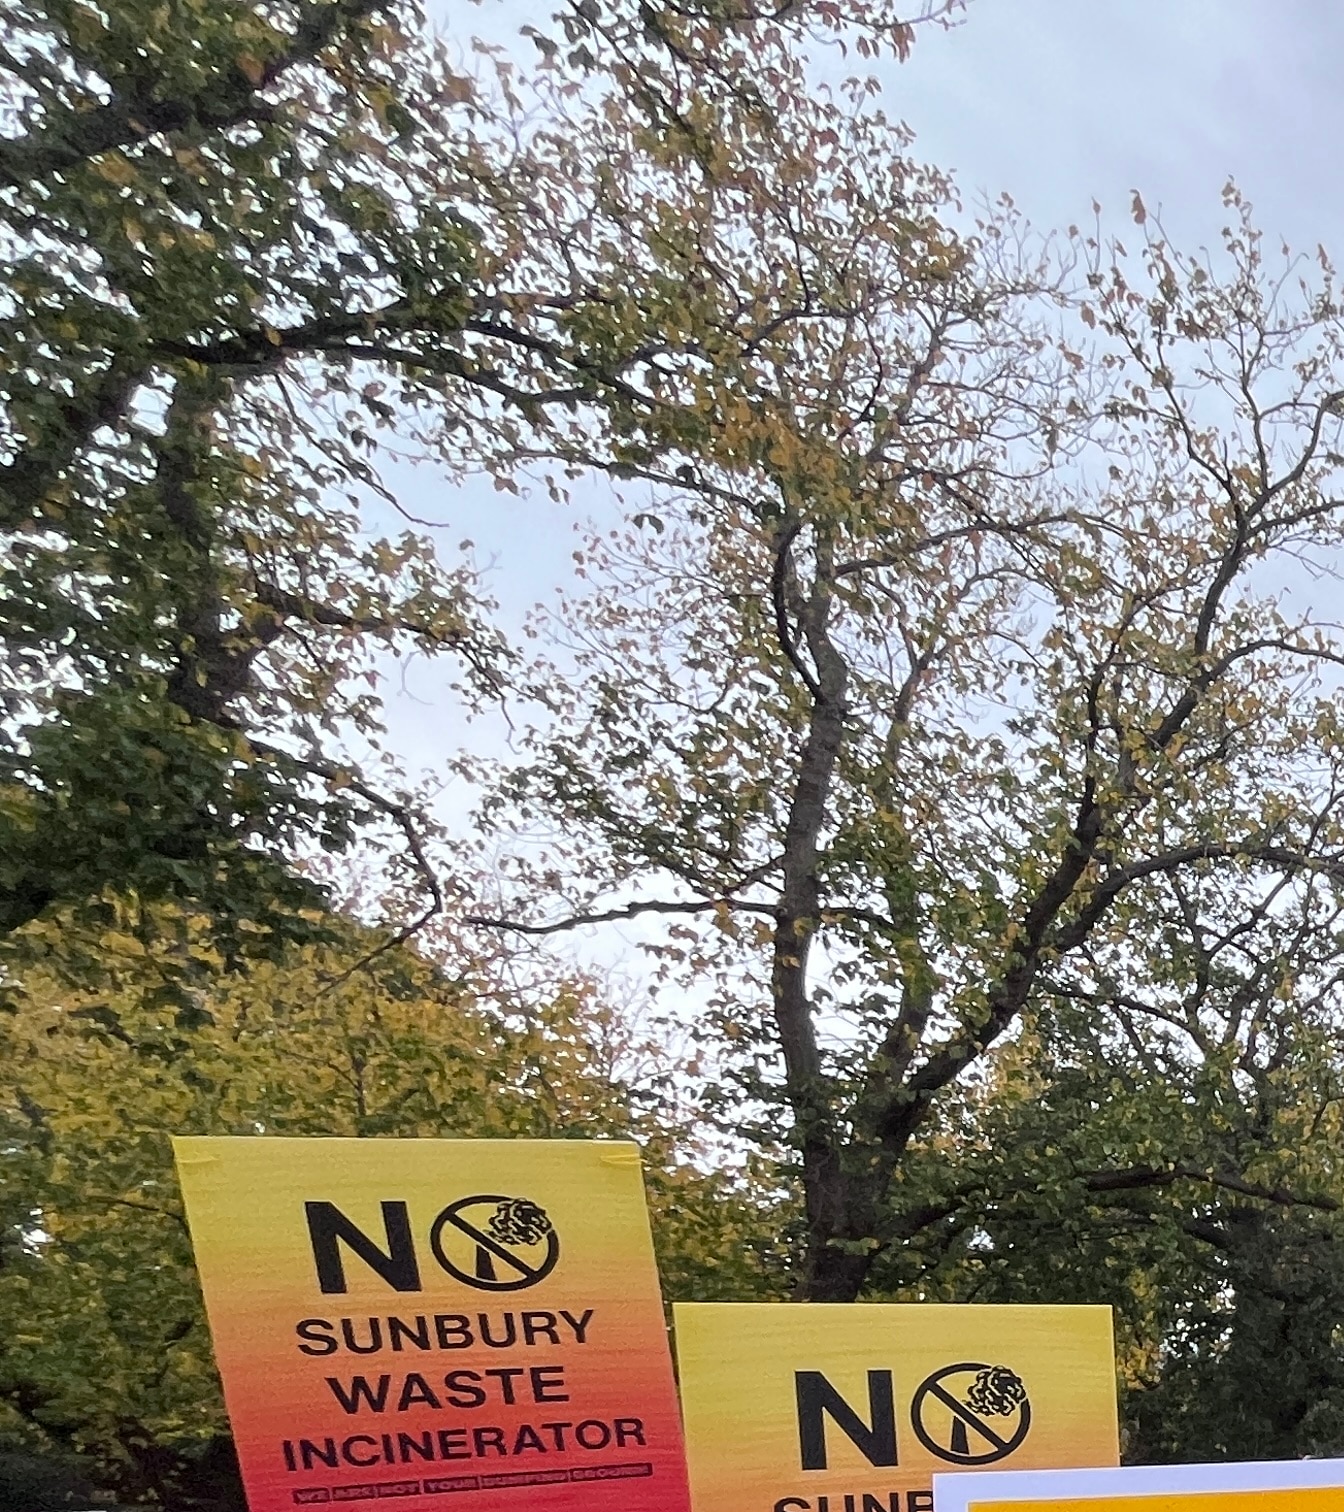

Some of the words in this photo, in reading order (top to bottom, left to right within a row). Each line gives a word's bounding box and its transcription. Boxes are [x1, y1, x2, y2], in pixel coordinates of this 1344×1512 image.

[296, 1309, 594, 1356] SUNBURY
[325, 1366, 570, 1415] WASTE
[282, 1418, 646, 1471] INCINERATOR
